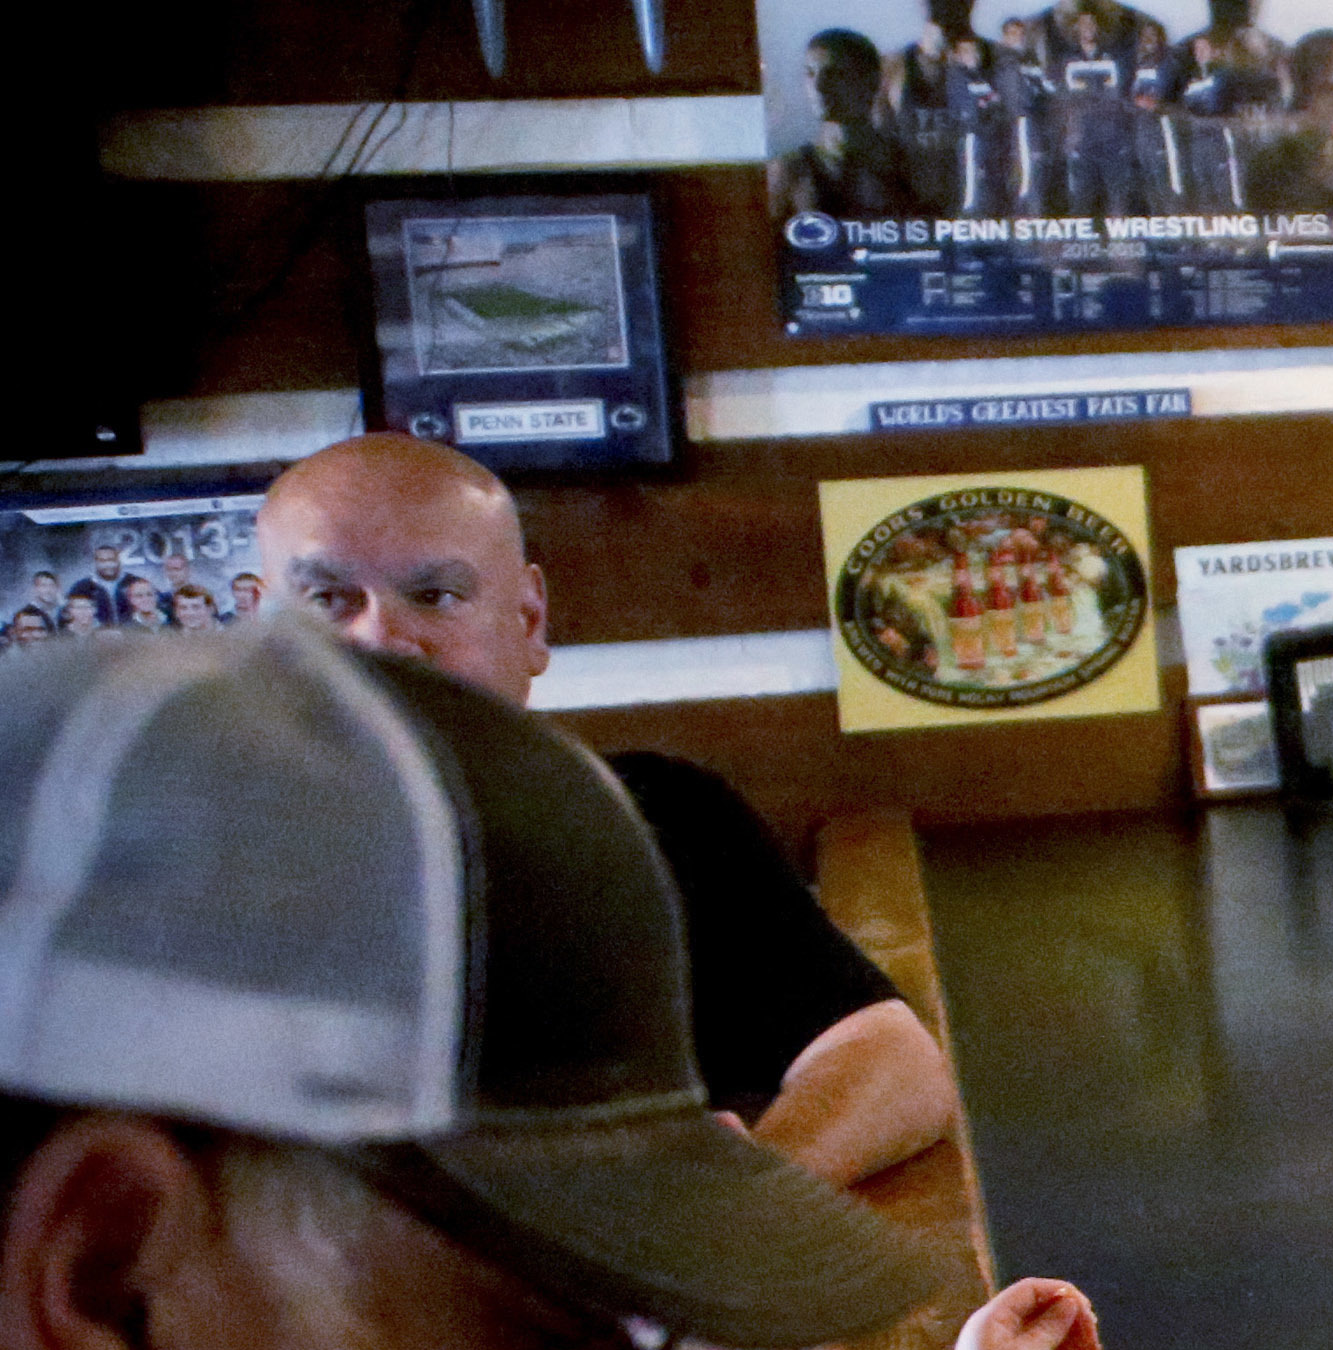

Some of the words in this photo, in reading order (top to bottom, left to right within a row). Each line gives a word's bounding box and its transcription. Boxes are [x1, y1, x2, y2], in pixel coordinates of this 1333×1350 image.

[842, 221, 898, 244] THIS
[905, 220, 929, 242] IS
[935, 219, 1008, 242] PENN
[1014, 217, 1099, 240] STATE.
[1105, 214, 1258, 238] WRESTLING
[1263, 213, 1329, 236] LIVES
[469, 414, 523, 432] PENN
[530, 411, 588, 429] STATE
[971, 399, 1077, 422] GREATEST
[849, 506, 924, 575] COORS
[939, 491, 1050, 513] GOLDEN
